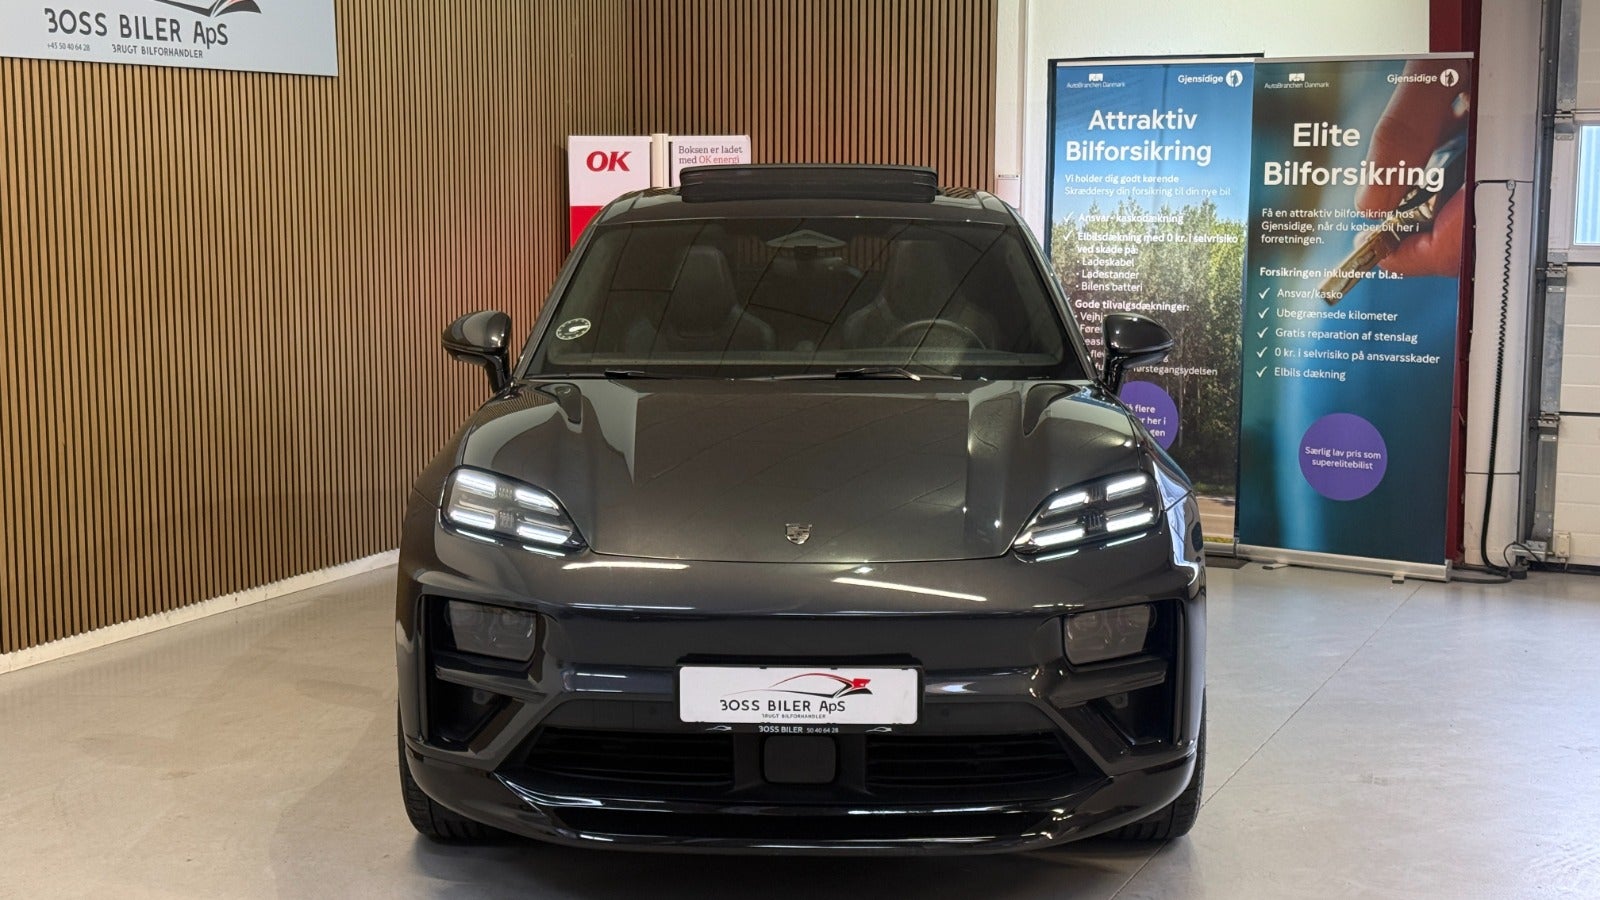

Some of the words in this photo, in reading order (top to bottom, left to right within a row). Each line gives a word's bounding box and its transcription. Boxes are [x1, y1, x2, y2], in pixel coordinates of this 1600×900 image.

[119, 14, 182, 42] BILER
[193, 20, 229, 49] ApS
[141, 45, 203, 59] BILFORHANDLER
[1177, 74, 1224, 85] Gjensidige
[1304, 81, 1329, 89] Danmark
[1387, 74, 1438, 85] Gjensidige
[1088, 108, 1198, 131] Attraktiv
[1293, 122, 1361, 147] Elite
[678, 145, 709, 154] Boksen
[721, 145, 743, 154] ladet
[1066, 139, 1212, 167] Bilforsikring
[586, 150, 632, 172] OK
[679, 155, 697, 164] med
[698, 155, 712, 164] OK
[713, 155, 740, 165] energi
[1065, 174, 1074, 183] Vi
[1075, 174, 1102, 183] holder
[1105, 174, 1119, 184] dig
[1120, 174, 1141, 184] godt
[1264, 161, 1445, 192] Bilforsikring
[1064, 187, 1114, 198] Skræddersy
[1116, 187, 1130, 196] din
[1132, 187, 1173, 198] forsikring
[1174, 187, 1184, 196] til
[1185, 187, 1200, 196] din
[1201, 189, 1218, 198] nye
[1219, 187, 1231, 196] bil
[1116, 213, 1184, 225] kaskodækning
[1262, 208, 1274, 218] Få
[1275, 210, 1288, 218] en
[1289, 208, 1331, 218] attraktiv
[1334, 209, 1393, 220] bilforsikring
[1395, 210, 1414, 219] hos
[1261, 222, 1315, 232] Gjensidige,
[1317, 221, 1333, 231] når
[1336, 222, 1348, 231] du
[1350, 222, 1379, 232] køber
[1381, 223, 1394, 232] bil
[1396, 223, 1413, 232] her
[1416, 223, 1420, 232] i
[1077, 232, 1142, 244] Elbilsdækning
[1143, 233, 1165, 243] med
[1166, 233, 1173, 242] 0
[1175, 234, 1188, 243] kr.
[1193, 234, 1238, 244] selvrisiko
[1261, 234, 1325, 245] forretningen.
[1077, 246, 1093, 255] ved
[1095, 246, 1123, 255] skade
[1124, 246, 1139, 257] på:
[1082, 258, 1135, 267] Ladeskabel
[1081, 270, 1140, 279] Ladestander
[1259, 267, 1322, 279] Forsikringen
[1323, 268, 1375, 279] inkluderer
[1378, 270, 1403, 280] bl.a.:
[1081, 282, 1110, 291] Bilens
[1111, 283, 1143, 292] batteri
[1277, 288, 1343, 300] Ansvar/kasko
[1075, 299, 1100, 309] Gode
[1102, 300, 1190, 313] tilvalgsdækninger:
[1080, 311, 1104, 324] Vejhj
[1276, 308, 1346, 320] Ubegrænsede
[1349, 310, 1398, 321] kilometer
[1275, 328, 1305, 338] Gratis
[1307, 331, 1360, 341] reparation
[1361, 331, 1372, 341] af
[1374, 333, 1418, 344] stenslag
[1275, 347, 1281, 357] 0
[1284, 348, 1296, 357] kr.
[1303, 349, 1350, 360] selvrisiko
[1351, 351, 1365, 362] på
[1367, 353, 1440, 364] ansvarsskader
[1274, 367, 1301, 377] Elbils
[1303, 369, 1346, 381] dækning
[1135, 404, 1156, 413] flere
[1147, 417, 1162, 425] her
[1305, 446, 1331, 457] Særlig
[1333, 448, 1345, 456] lav
[1346, 449, 1362, 459] pris
[1363, 452, 1382, 460] som
[1311, 459, 1374, 470] superelitebilist
[768, 699, 811, 712] BILER
[819, 700, 846, 714] ApS
